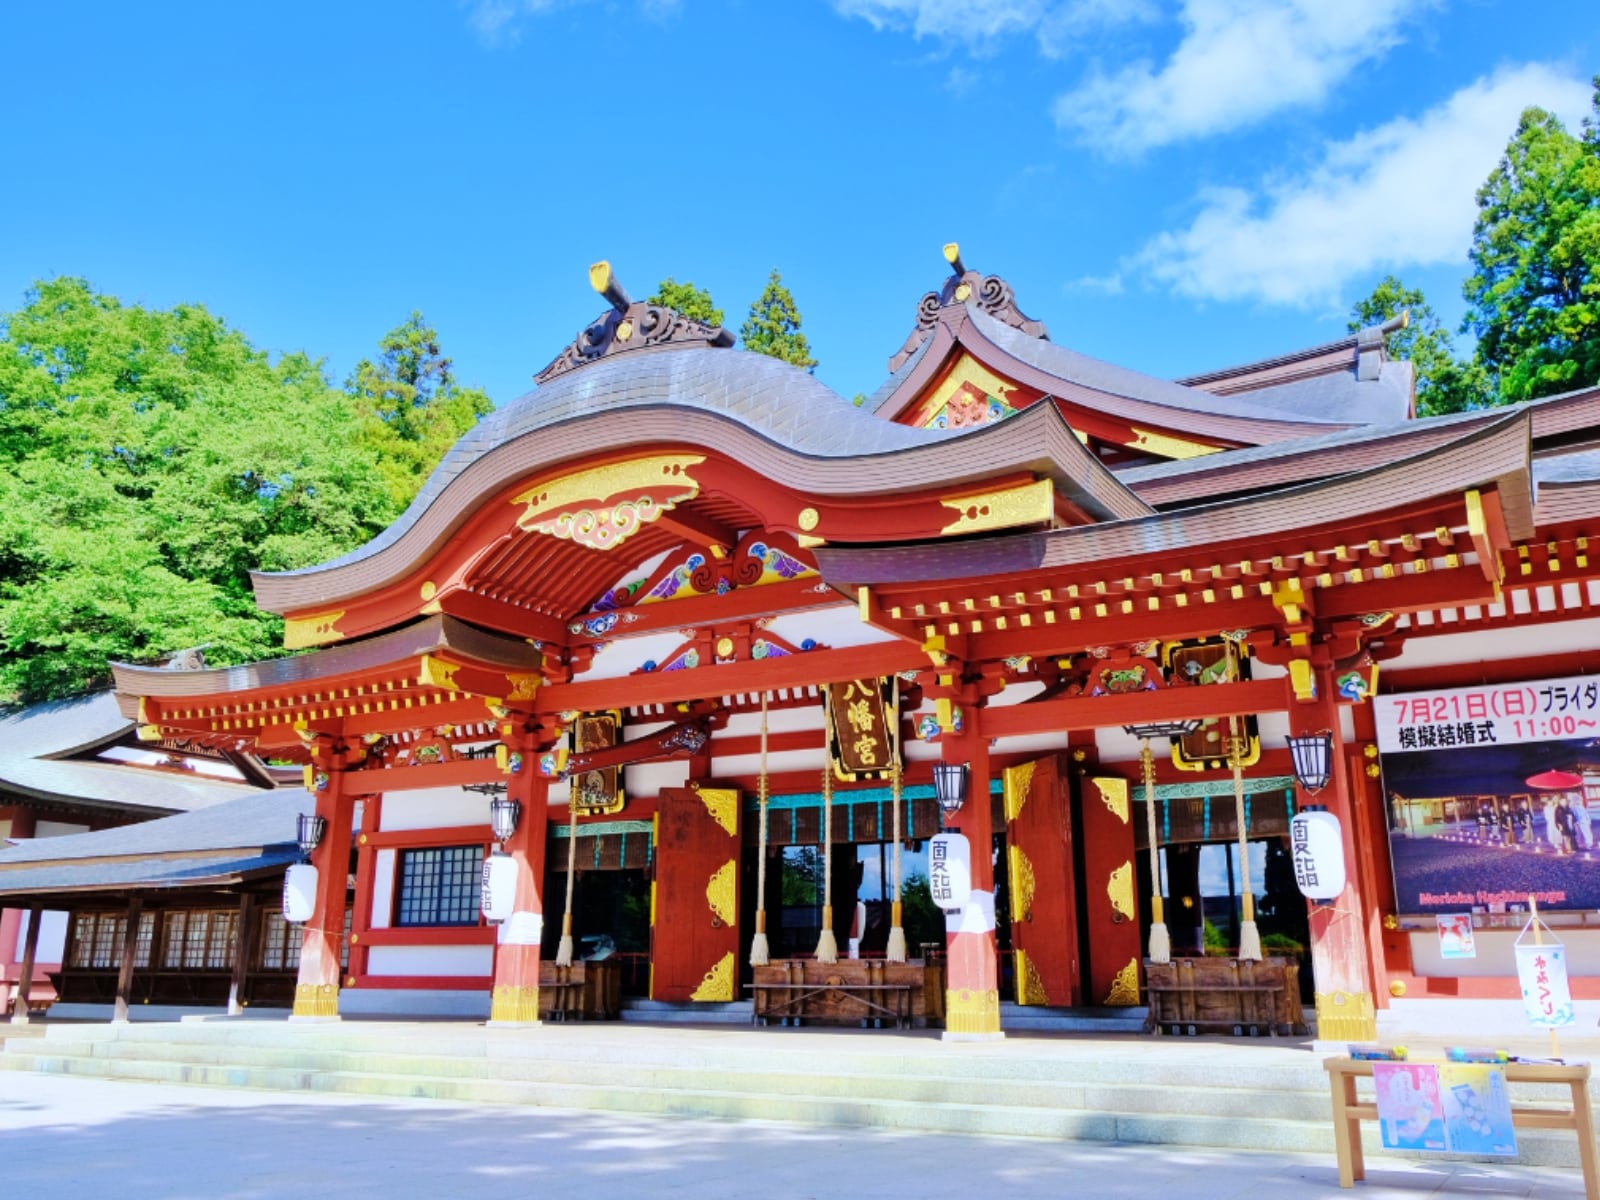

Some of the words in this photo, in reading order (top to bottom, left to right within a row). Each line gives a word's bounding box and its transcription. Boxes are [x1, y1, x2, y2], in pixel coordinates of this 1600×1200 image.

[842, 679, 878, 765] 八幡宮
[1399, 721, 1497, 749] 模擬結婚式
[932, 841, 952, 901] 夏詣
[1293, 819, 1319, 888] 夏詣
